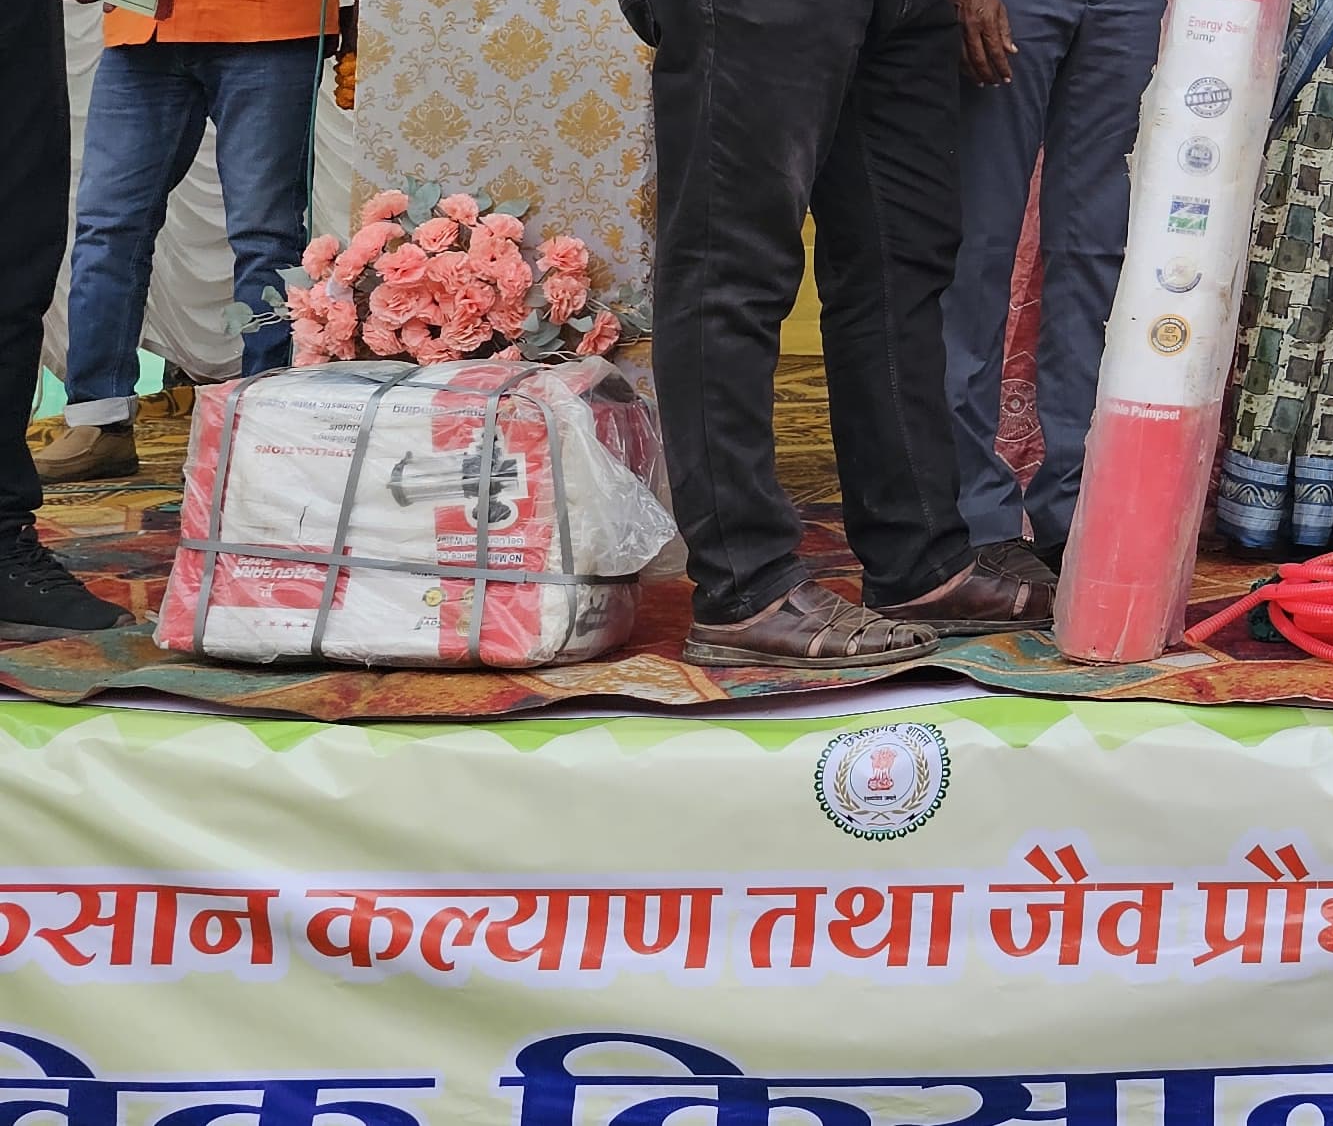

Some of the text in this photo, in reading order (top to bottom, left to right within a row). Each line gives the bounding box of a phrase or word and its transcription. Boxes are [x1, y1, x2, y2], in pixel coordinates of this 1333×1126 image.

[1188, 15, 1222, 33] Energy
[1186, 30, 1216, 43] Pump
[319, 401, 364, 412] Domestic
[1130, 405, 1181, 422] Pumpset
[254, 445, 353, 458] APPLICATIONS
[509, 554, 522, 562] No
[306, 886, 722, 972] कल्याण
[747, 884, 964, 968] तथा
[989, 844, 1173, 966] जैव
